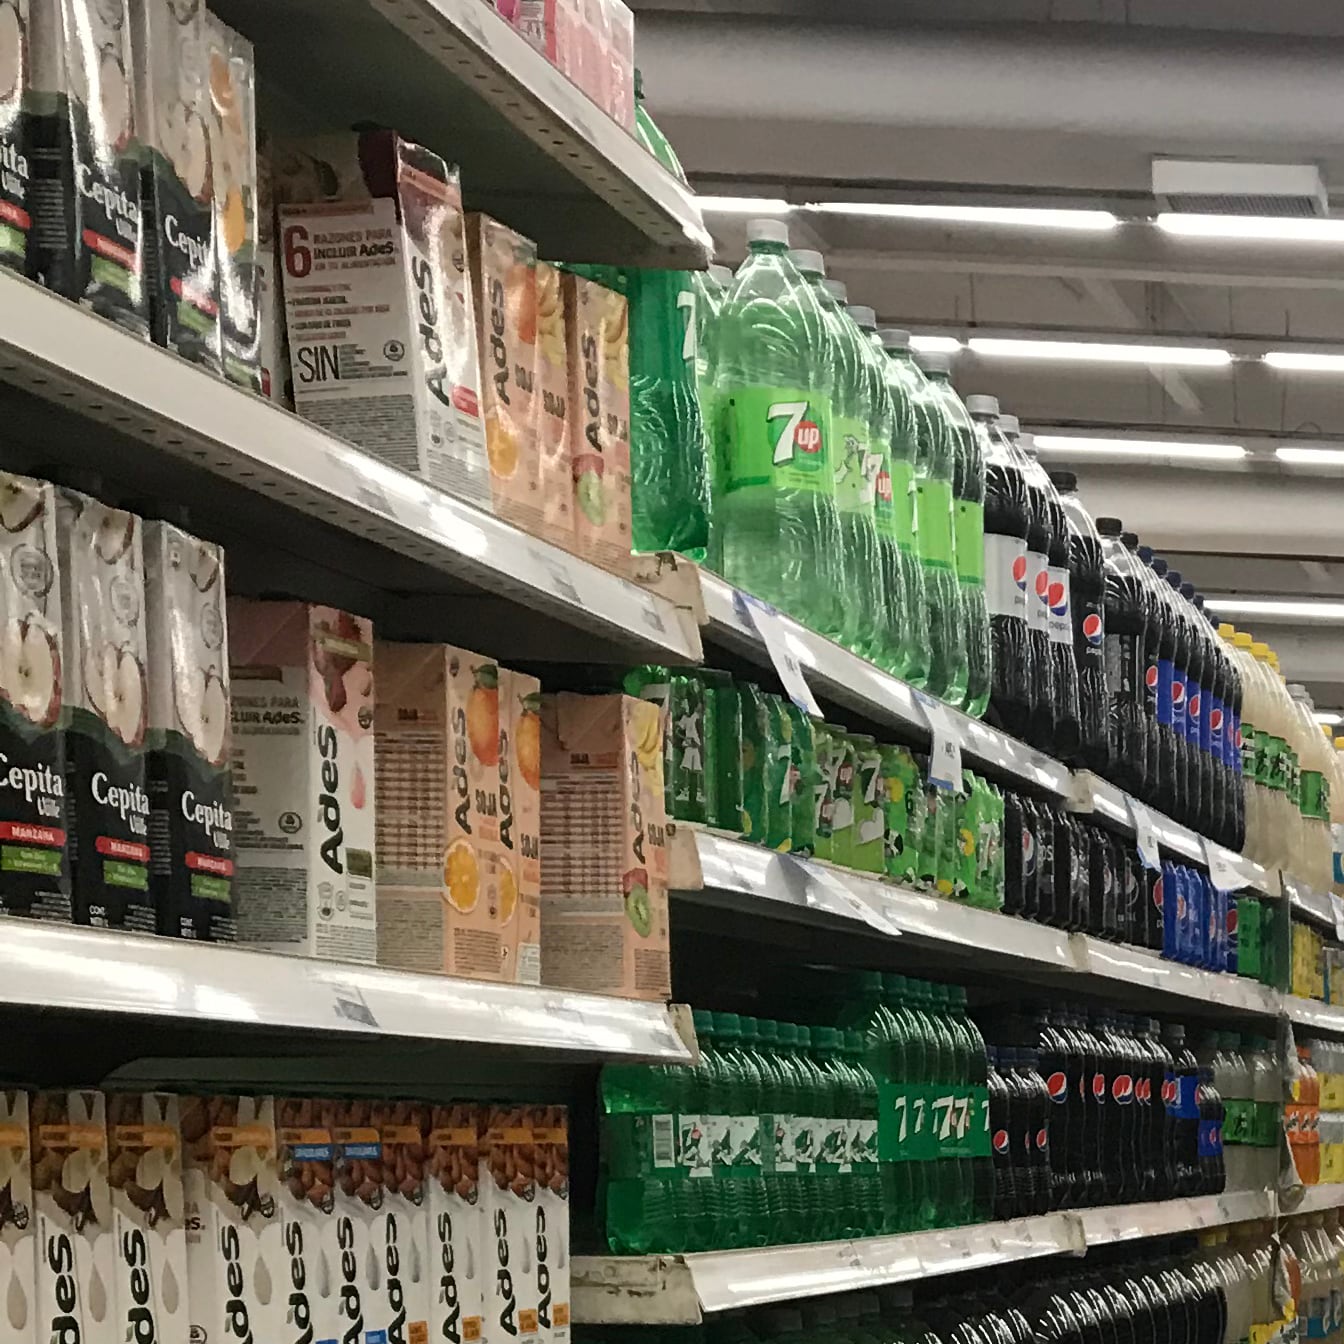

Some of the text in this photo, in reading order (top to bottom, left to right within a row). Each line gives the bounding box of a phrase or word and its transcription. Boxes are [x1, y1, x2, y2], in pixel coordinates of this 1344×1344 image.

[284, 225, 312, 278] 6
[314, 248, 356, 259] INCLUIR
[297, 345, 341, 383] SIN
[91, 772, 150, 820] Cepita
[181, 790, 232, 836] Cepita
[11, 826, 55, 842] MANZANA
